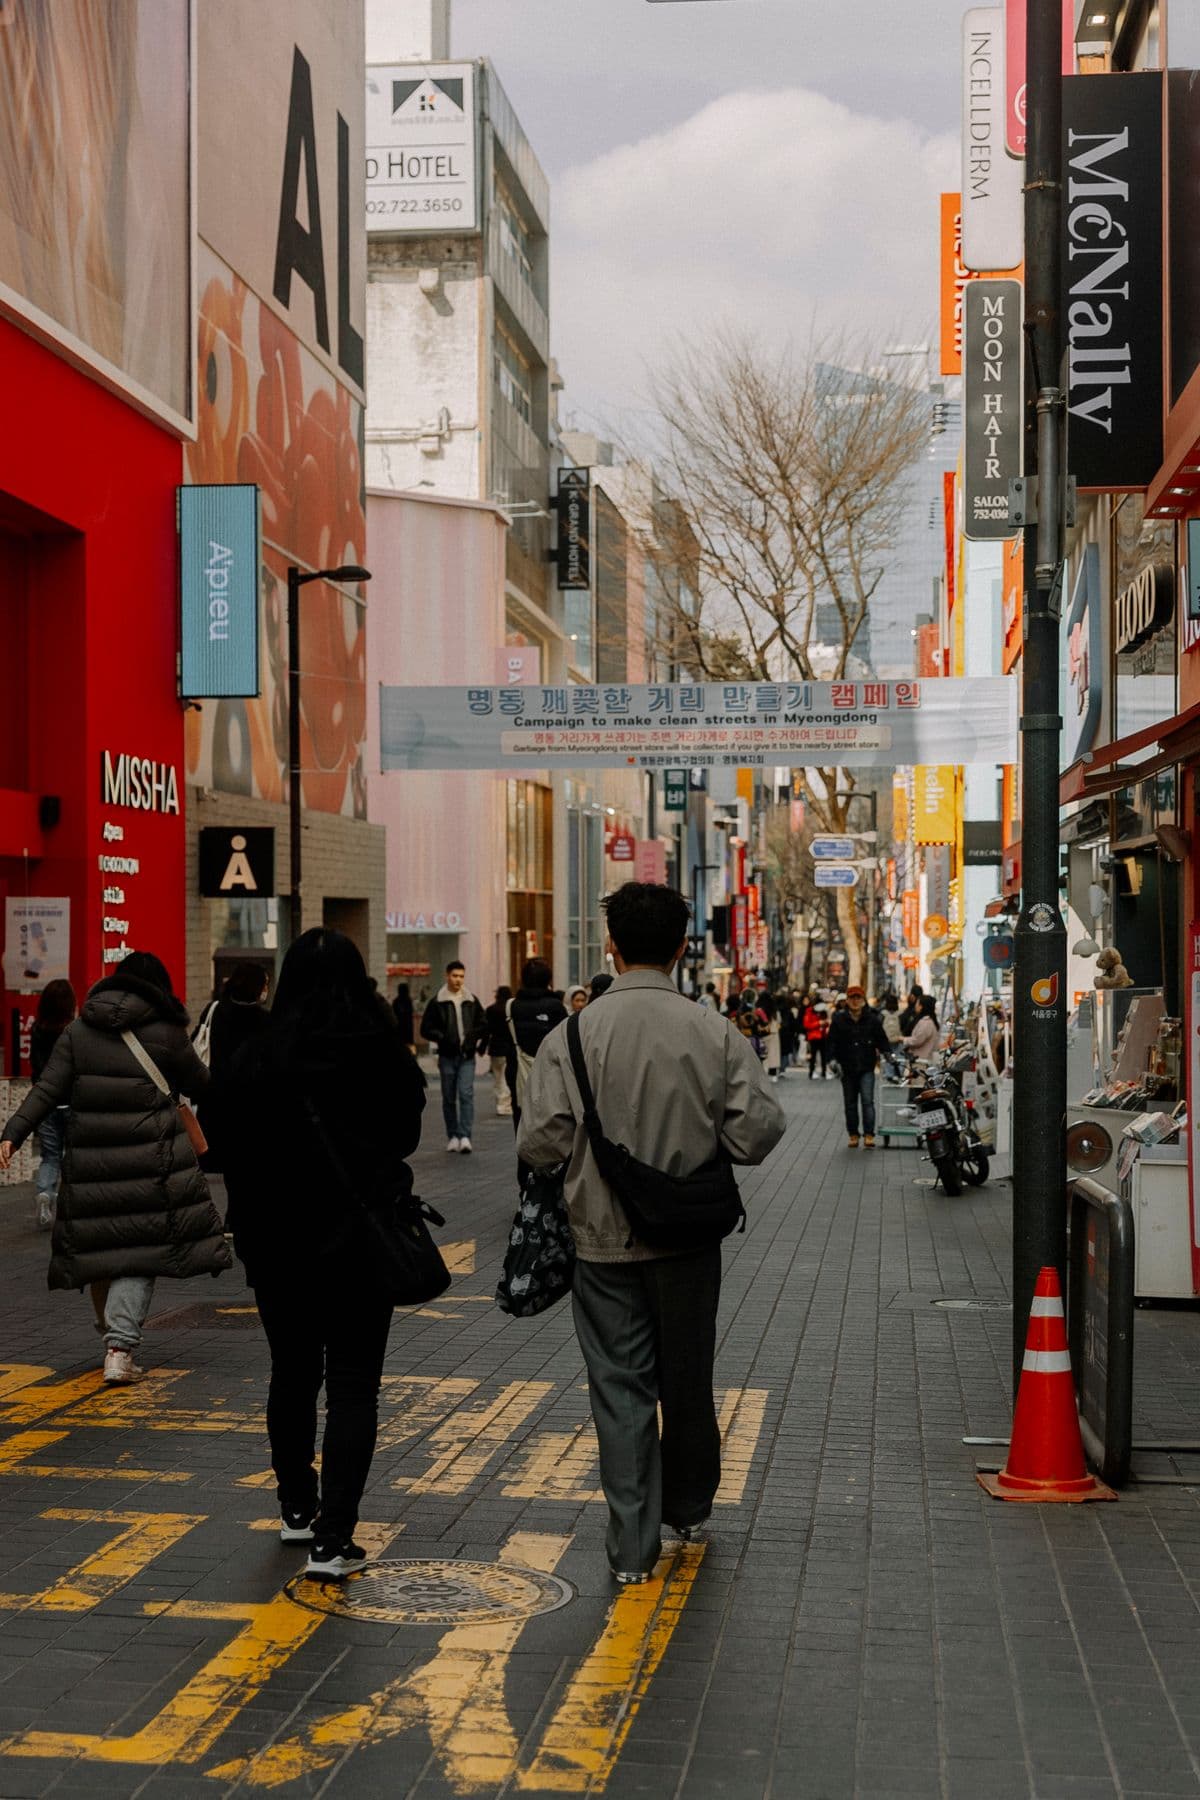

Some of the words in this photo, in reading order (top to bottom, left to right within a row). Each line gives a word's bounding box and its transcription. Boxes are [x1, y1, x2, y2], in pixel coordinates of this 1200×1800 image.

[969, 32, 992, 200] INCELLDERM
[982, 296, 1005, 382] MOON
[983, 394, 1003, 479] HAIR
[973, 495, 1009, 507] SALON
[467, 689, 526, 716] 명동
[648, 687, 705, 713] 거리
[723, 686, 813, 712] 만들기
[830, 682, 922, 710] 캠페인
[513, 716, 585, 729] Campaign
[592, 717, 607, 727] to
[613, 715, 652, 727] make
[659, 714, 698, 726] clean
[705, 714, 757, 725] streets
[764, 714, 777, 724] in
[784, 712, 877, 726] Myeongdong
[534, 732, 555, 745] 명동
[605, 731, 646, 743] 쓰레기는
[651, 731, 672, 743] 주변
[734, 730, 764, 741] 주시면
[513, 744, 546, 753] Garbage
[568, 744, 618, 753] Myeongdong
[693, 743, 728, 751] collected
[753, 743, 770, 751] give
[804, 742, 831, 750] nearby
[859, 741, 880, 749] store
[103, 750, 179, 816] MISSHA
